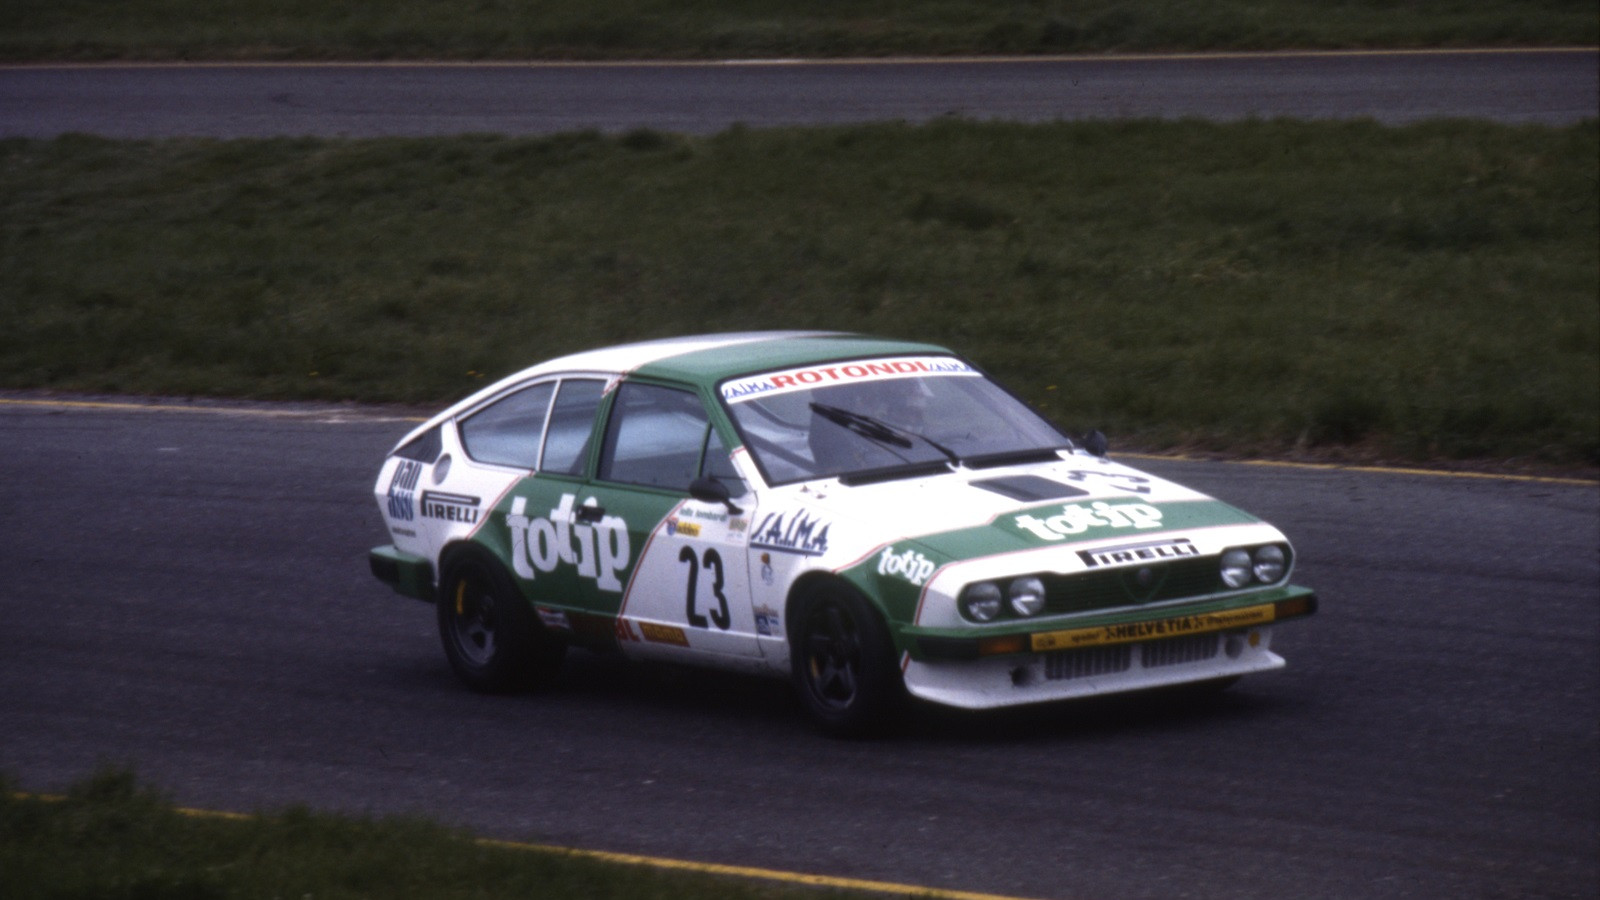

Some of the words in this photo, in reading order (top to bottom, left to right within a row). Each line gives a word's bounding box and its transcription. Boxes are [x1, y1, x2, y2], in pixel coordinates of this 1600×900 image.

[769, 361, 929, 389] ROTONDI
[420, 490, 481, 524] PIRELLI
[1015, 502, 1163, 541] totip
[506, 493, 630, 592] totip
[1075, 538, 1200, 568] PIRELLI
[877, 546, 935, 587] totip
[679, 545, 730, 631] 23
[1117, 616, 1191, 638] HELVETIA
